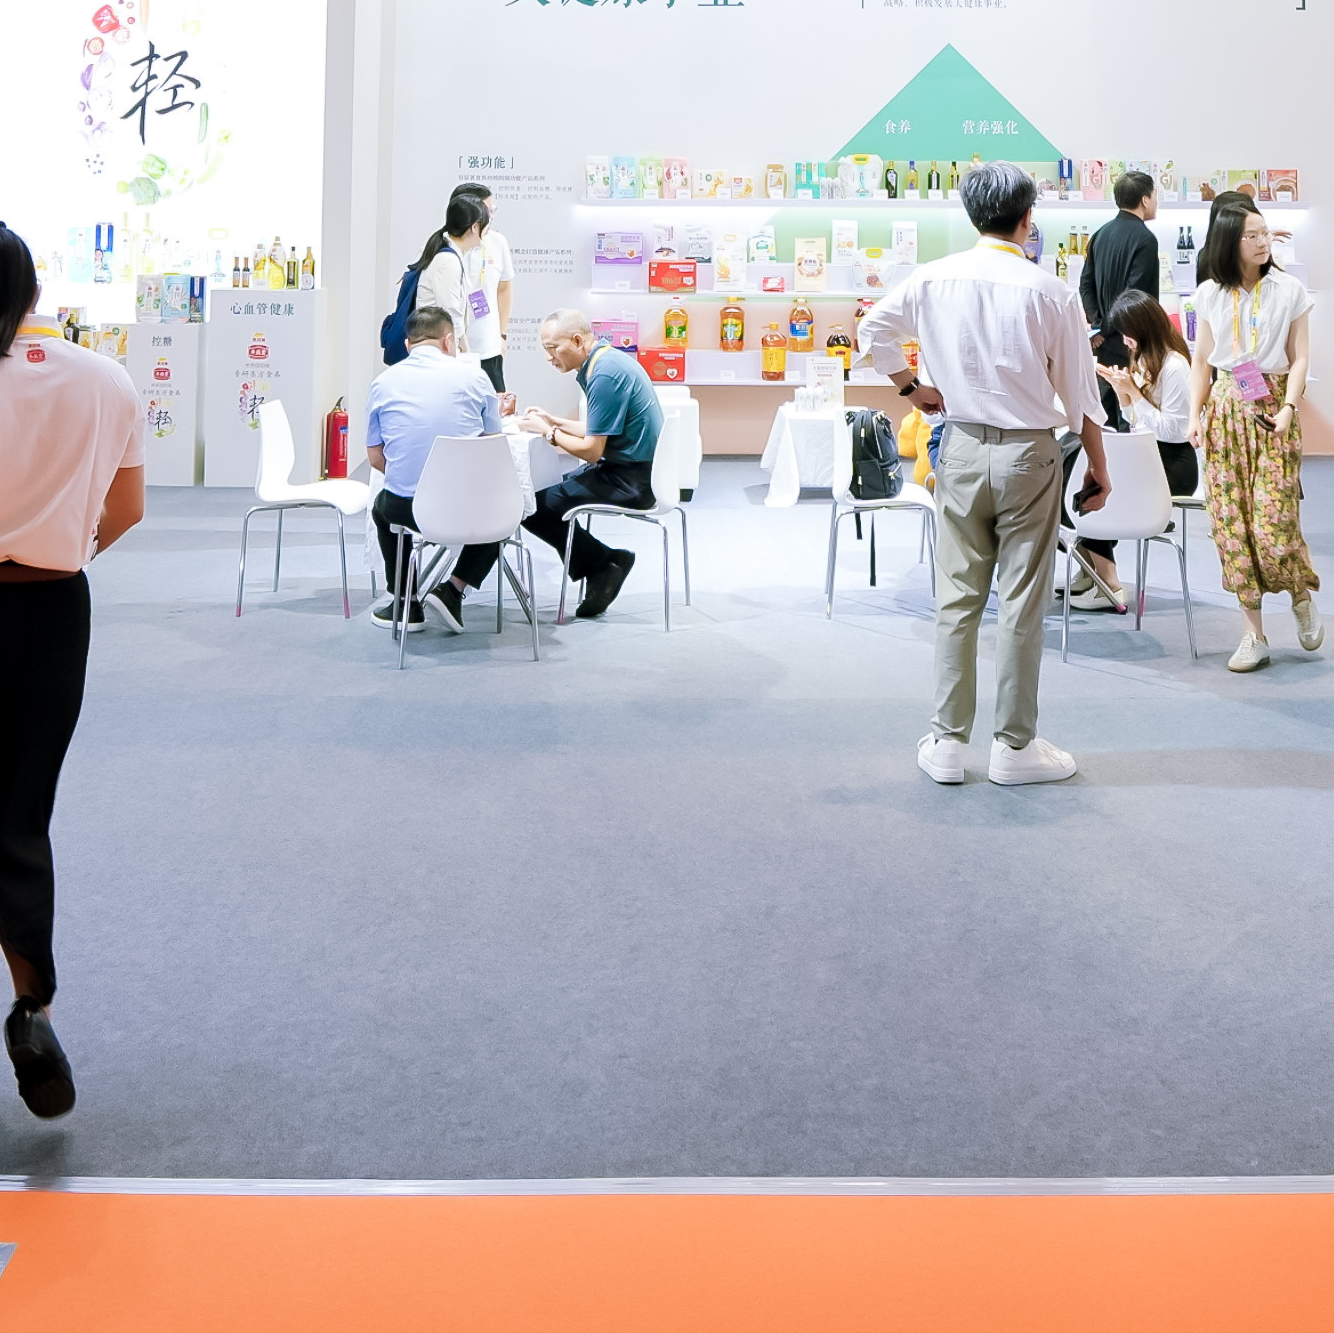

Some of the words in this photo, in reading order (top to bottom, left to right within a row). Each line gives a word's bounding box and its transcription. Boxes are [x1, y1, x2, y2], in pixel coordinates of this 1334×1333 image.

[120, 40, 201, 146] 轻
[883, 119, 912, 135] 食养
[962, 119, 1019, 136] 营养强化
[230, 302, 295, 317] 心血管健康
[151, 335, 173, 348] 控糖
